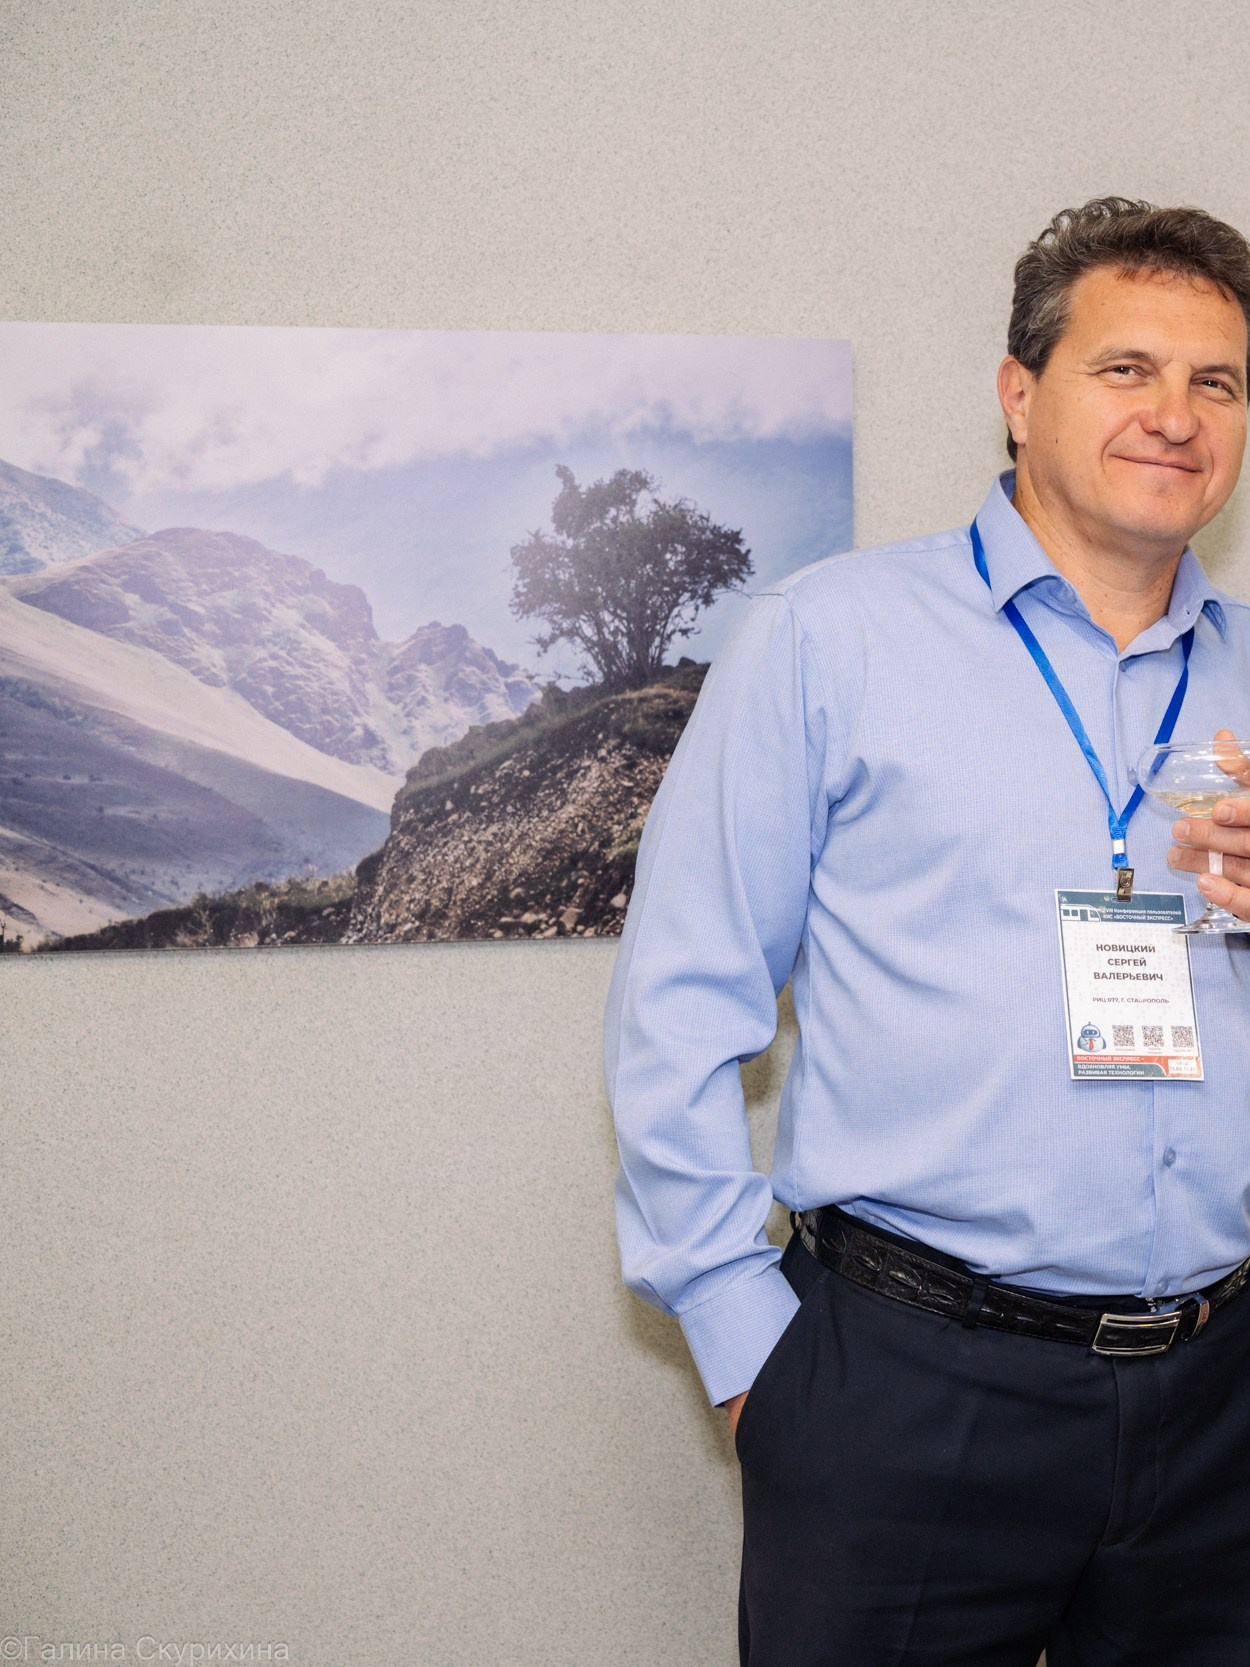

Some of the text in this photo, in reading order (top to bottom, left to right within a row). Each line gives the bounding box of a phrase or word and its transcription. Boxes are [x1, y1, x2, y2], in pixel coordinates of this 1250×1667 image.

[1095, 944, 1156, 953] НОВИЦКИЙ
[1107, 957, 1147, 967] СЕРГЕЙ
[1093, 972, 1164, 981] ВАЛЕРЬЕВИЧ
